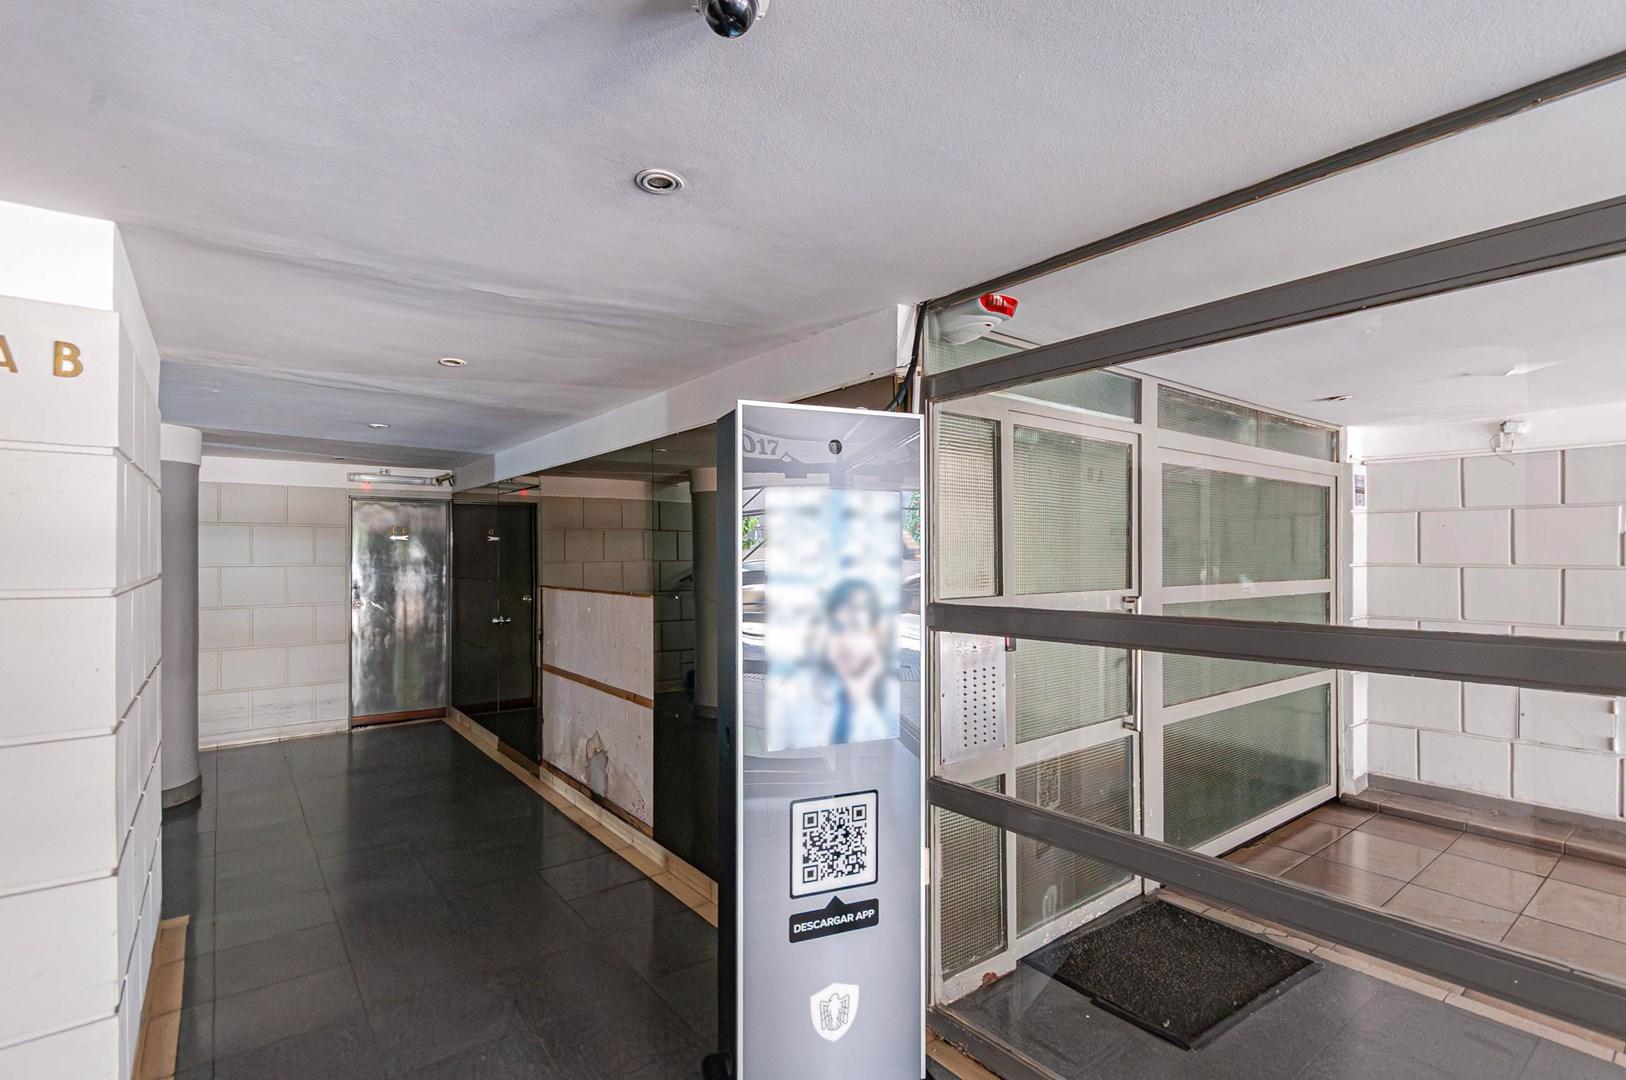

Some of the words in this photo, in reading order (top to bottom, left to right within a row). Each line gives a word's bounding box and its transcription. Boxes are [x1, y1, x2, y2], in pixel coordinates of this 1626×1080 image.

[53, 340, 84, 378] B
[793, 914, 854, 933] DESCARGAR
[855, 909, 875, 920] APP
